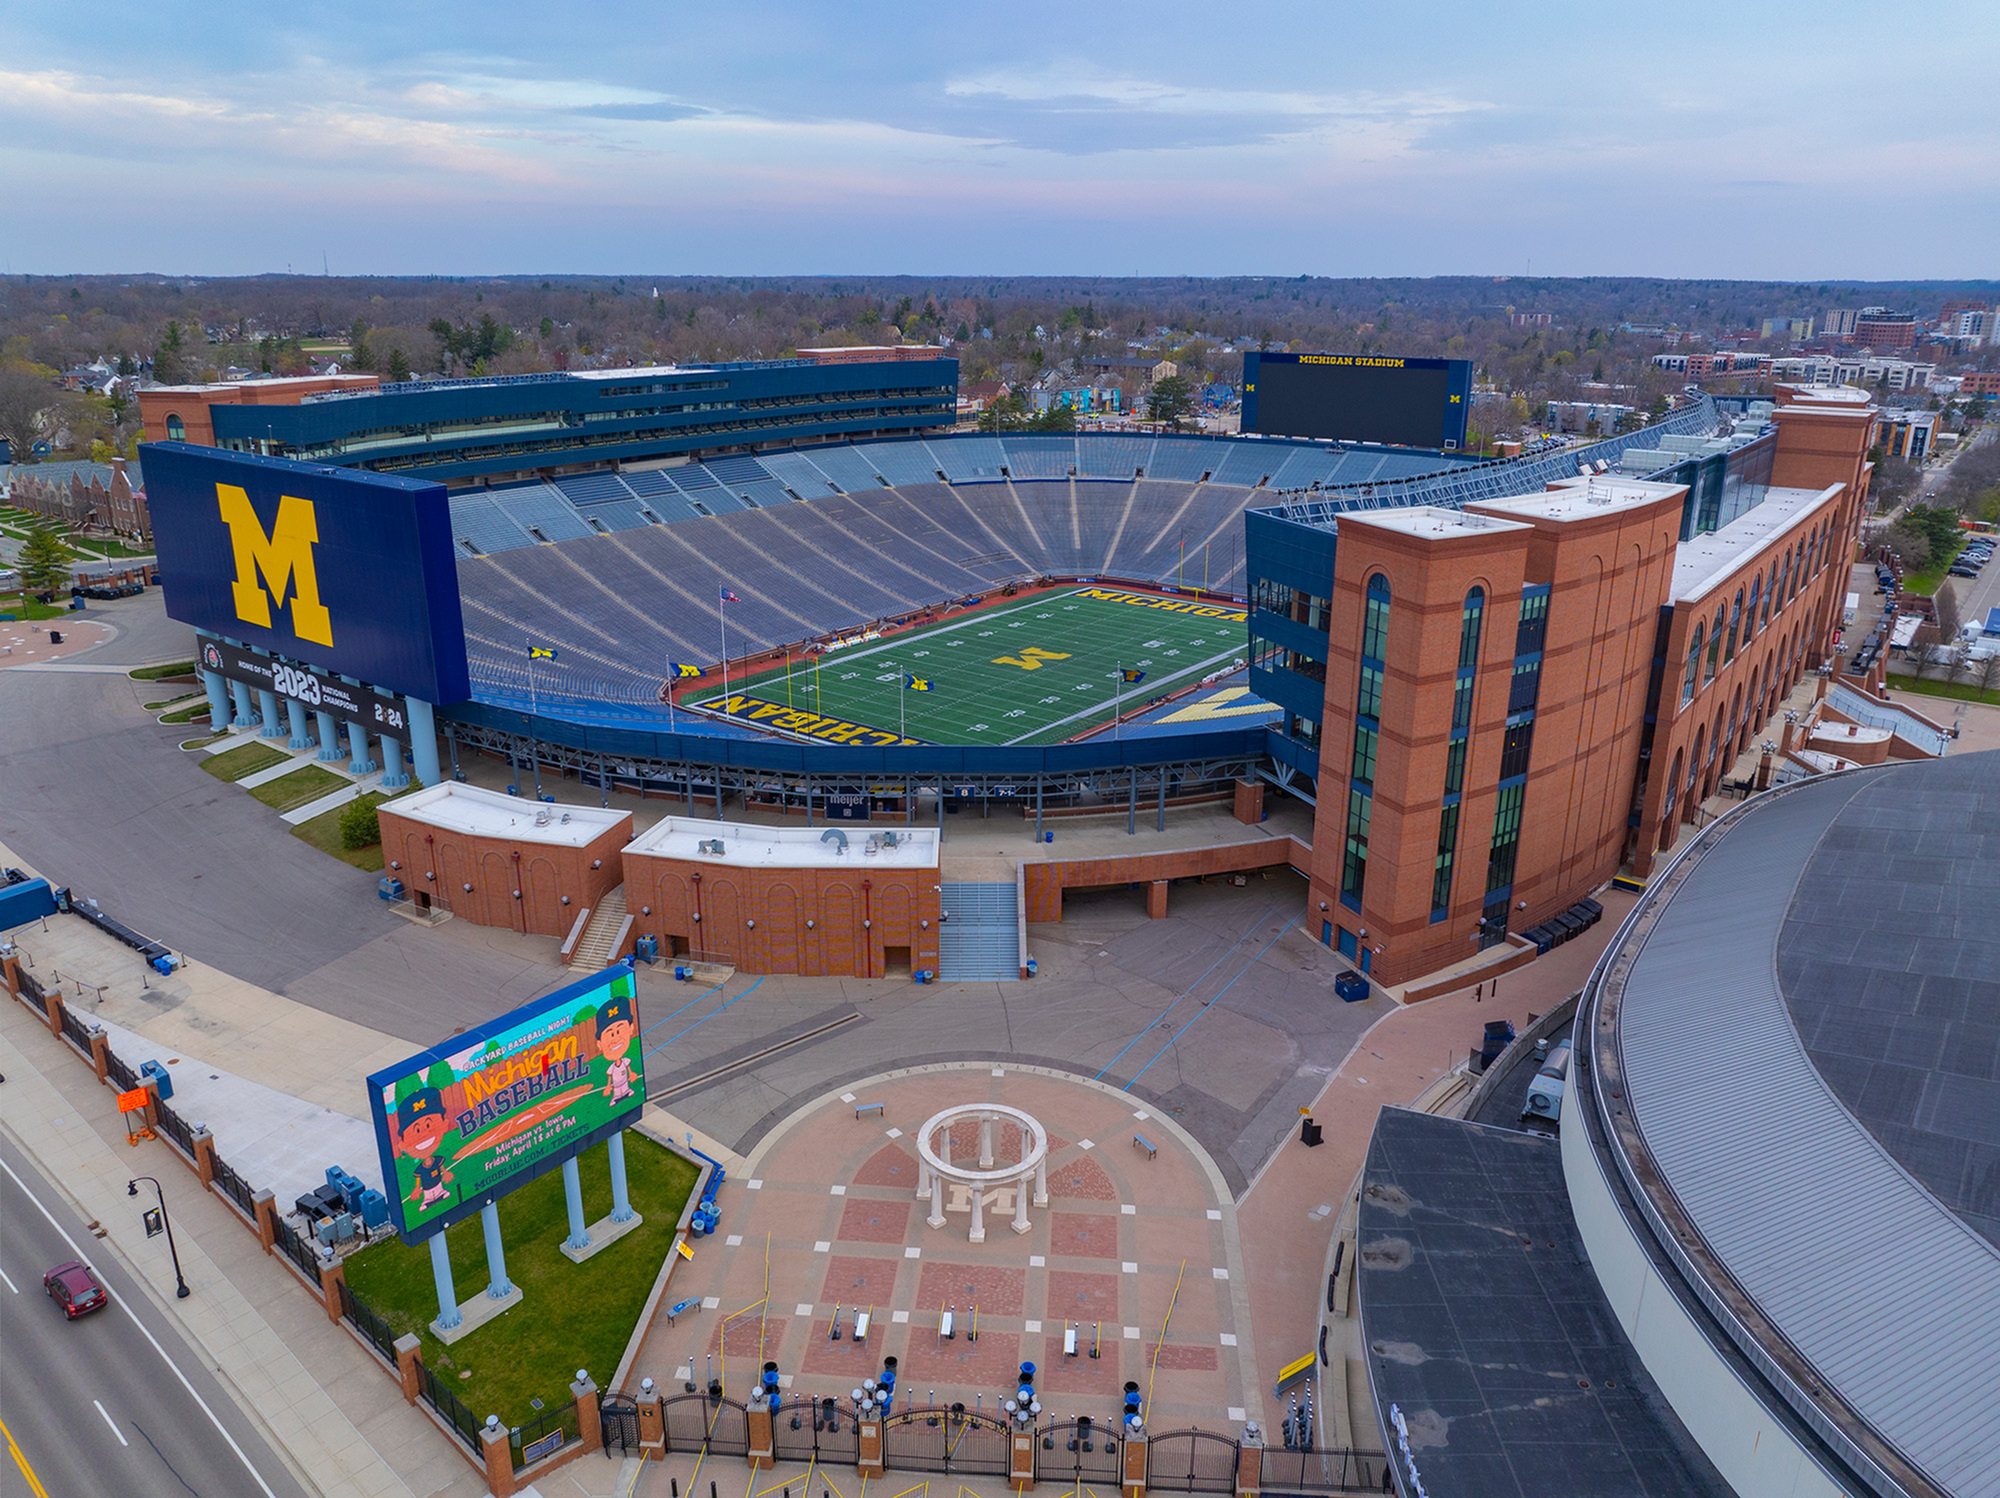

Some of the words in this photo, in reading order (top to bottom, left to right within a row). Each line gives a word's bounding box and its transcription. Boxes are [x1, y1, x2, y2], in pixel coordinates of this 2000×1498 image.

[1299, 355, 1353, 365] MICHIGAN
[1355, 357, 1405, 368] STADIUM
[1246, 384, 1255, 392] M
[1449, 395, 1460, 403] M
[215, 482, 334, 648] M
[1076, 588, 1248, 623] MICHIGA
[991, 646, 1072, 671] M
[238, 660, 254, 673] HOME
[253, 664, 261, 674] OF
[261, 667, 272, 678] THE
[271, 662, 321, 706] 2023
[322, 684, 351, 701] NATIONAL
[323, 694, 359, 713] CHAMPIONS
[830, 794, 864, 807] meijer
[607, 1006, 619, 1018] M
[463, 1045, 507, 1073] BACKYARD
[508, 1028, 546, 1051] BASEBALL
[548, 1014, 570, 1033] NIGHT
[463, 1035, 578, 1110] Michigan
[886, 1062, 965, 1078] PLAZA
[996, 1063, 1105, 1090] VARSITY
[412, 1098, 426, 1113] M
[455, 1052, 590, 1139] BASEBALL
[484, 1153, 511, 1171] Friday,
[512, 1140, 532, 1157] April
[534, 1133, 543, 1145] 18
[545, 1129, 554, 1139] at
[555, 1124, 561, 1133] 6
[562, 1115, 576, 1130] PM
[495, 1130, 532, 1155] Michigan
[533, 1125, 544, 1135] vs.
[545, 1114, 564, 1128] Iowa
[474, 1147, 545, 1192] MGOBLUE.COM
[551, 1123, 590, 1148] TICKETS
[946, 1185, 1018, 1215] M
